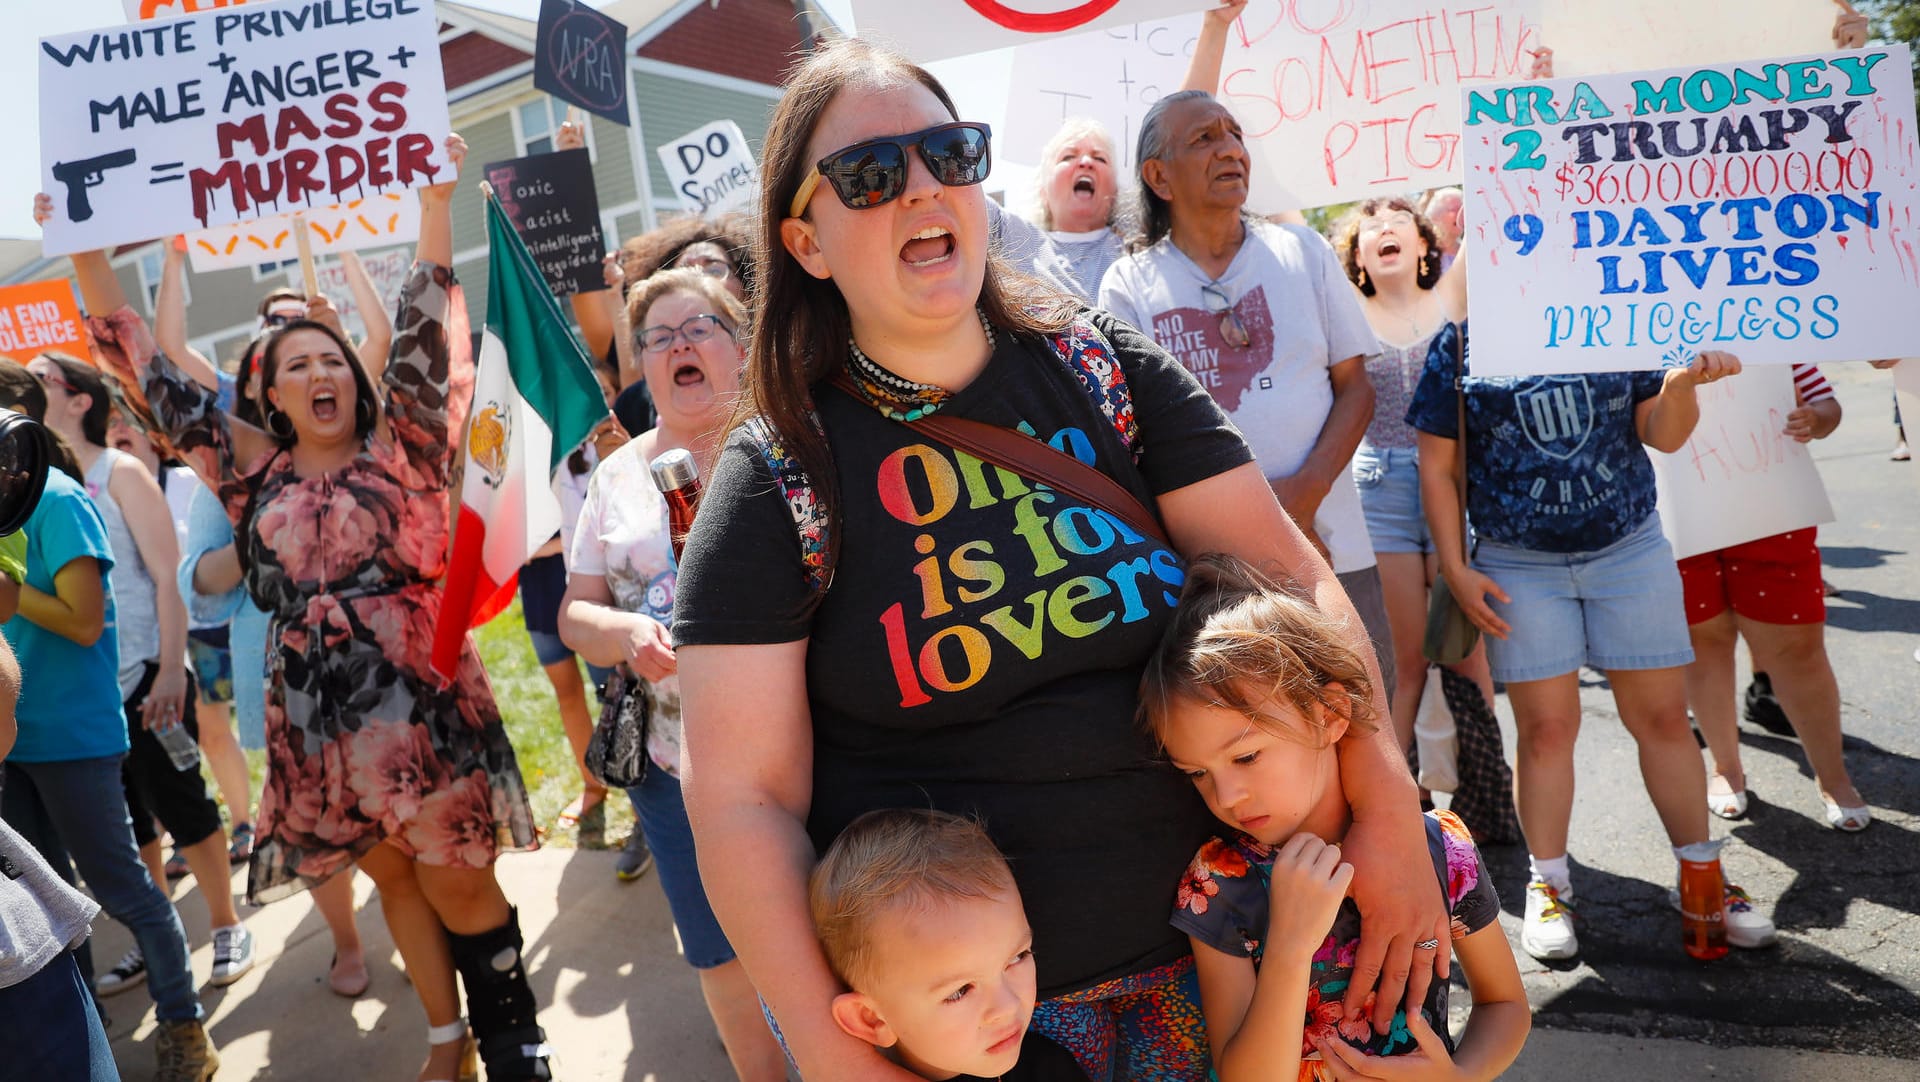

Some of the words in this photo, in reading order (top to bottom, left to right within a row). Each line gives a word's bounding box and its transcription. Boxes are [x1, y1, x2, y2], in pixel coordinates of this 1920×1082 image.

[42, 20, 197, 67] WHITE
[557, 28, 618, 99] NRA
[90, 79, 206, 133] MALE
[222, 50, 383, 113] ANGER
[1465, 82, 1614, 127] NRA
[1631, 53, 1888, 117] MONEY
[216, 81, 410, 158] MASS
[1502, 130, 1547, 171] 2
[1561, 100, 1863, 164] TRUMPY
[677, 132, 729, 175] DO
[189, 133, 440, 228] MURDER
[489, 165, 555, 202] Toxic
[527, 226, 601, 256] nintelligent
[1503, 214, 1544, 256] 9
[1570, 191, 1882, 249] DAYTON
[541, 249, 598, 279] isguided
[1596, 242, 1820, 295] LIVES
[15, 301, 60, 326] END
[1158, 313, 1183, 337] NO
[1544, 295, 1840, 348] PRICELESS
[1160, 330, 1206, 353] HATE
[1190, 347, 1219, 372] MY
[1530, 385, 1582, 442] OH
[877, 420, 1096, 526] Oho
[1530, 462, 1613, 503] OHIO
[913, 534, 1005, 619] is
[879, 550, 1185, 708] lovers
